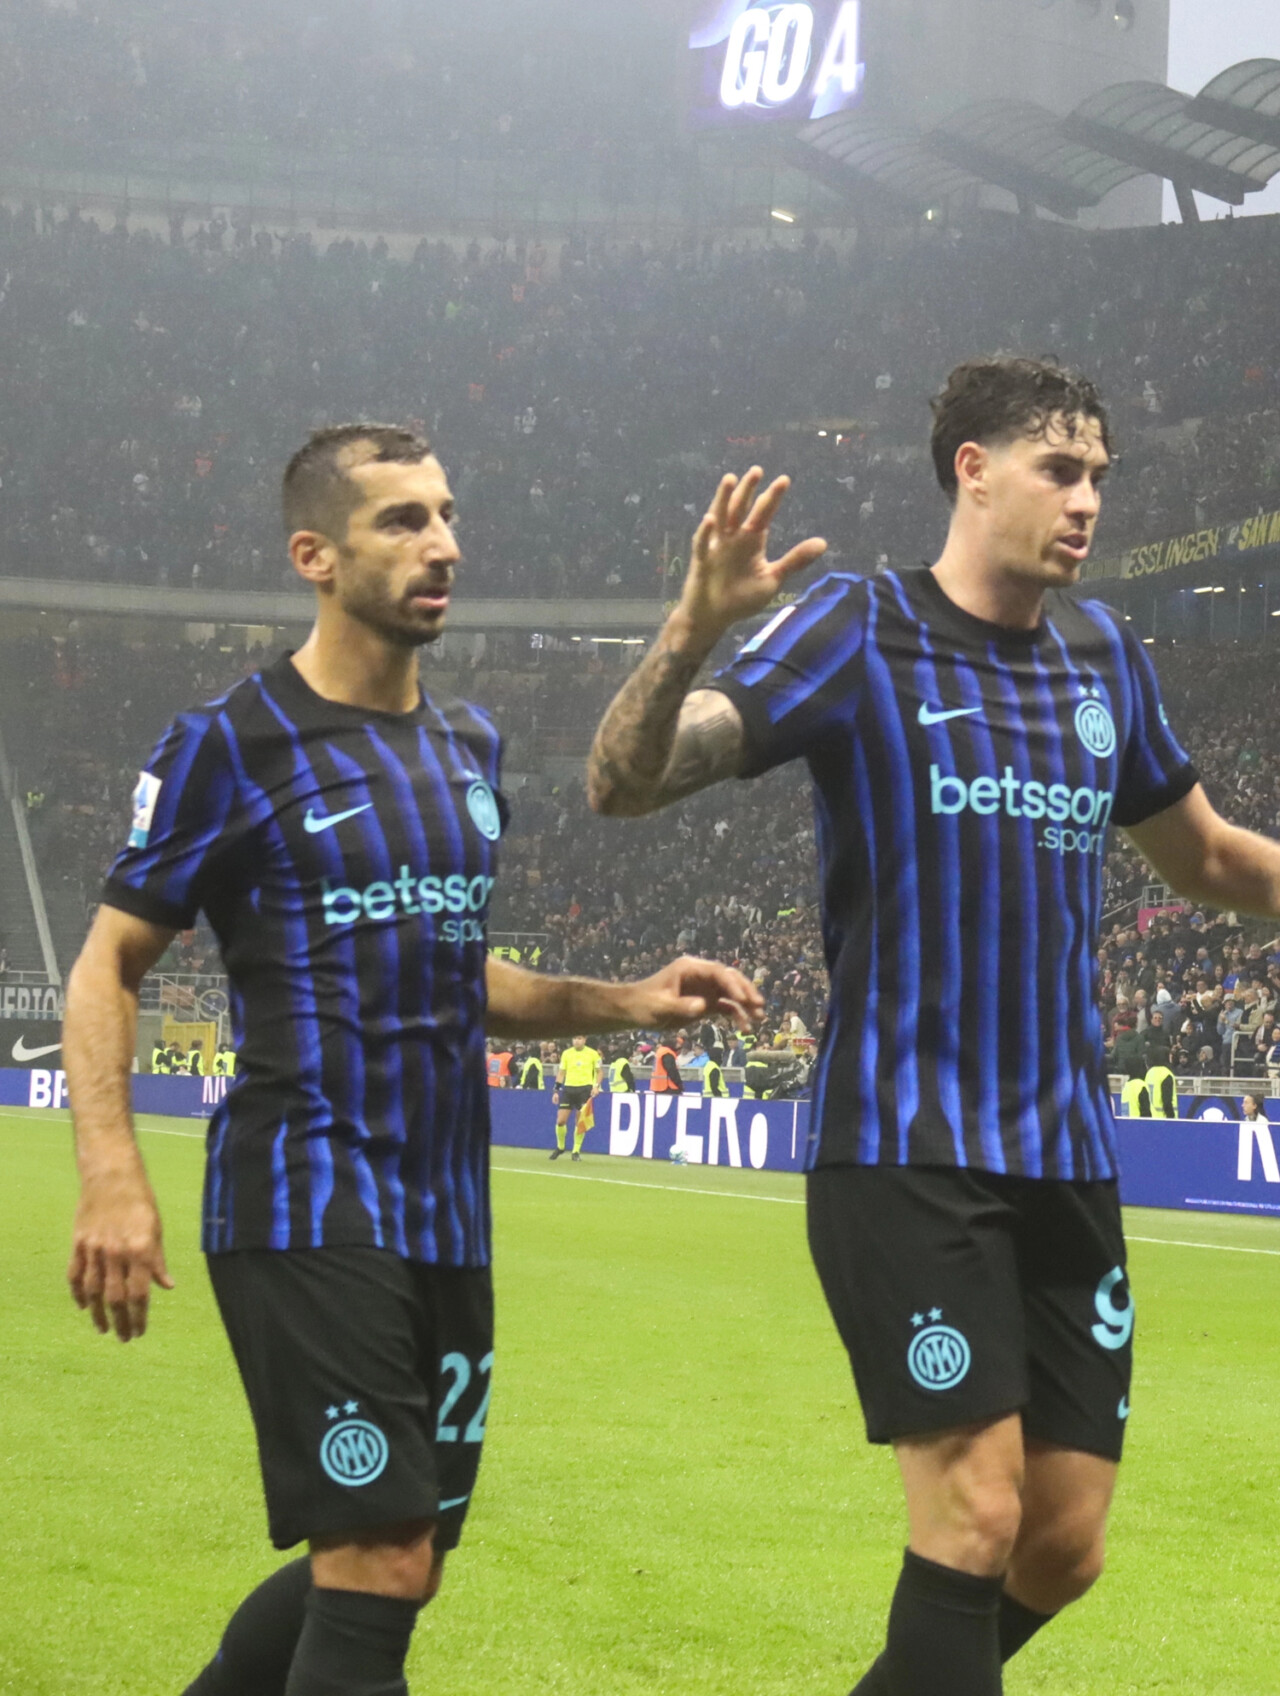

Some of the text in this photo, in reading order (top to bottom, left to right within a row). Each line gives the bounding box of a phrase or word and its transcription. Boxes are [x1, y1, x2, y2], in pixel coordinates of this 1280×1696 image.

[1124, 528, 1220, 579] ESSLINGEN
[1238, 512, 1270, 551] SAN
[929, 763, 1113, 827] betsson
[1091, 1265, 1135, 1350] 9
[436, 1350, 495, 1443] 22
